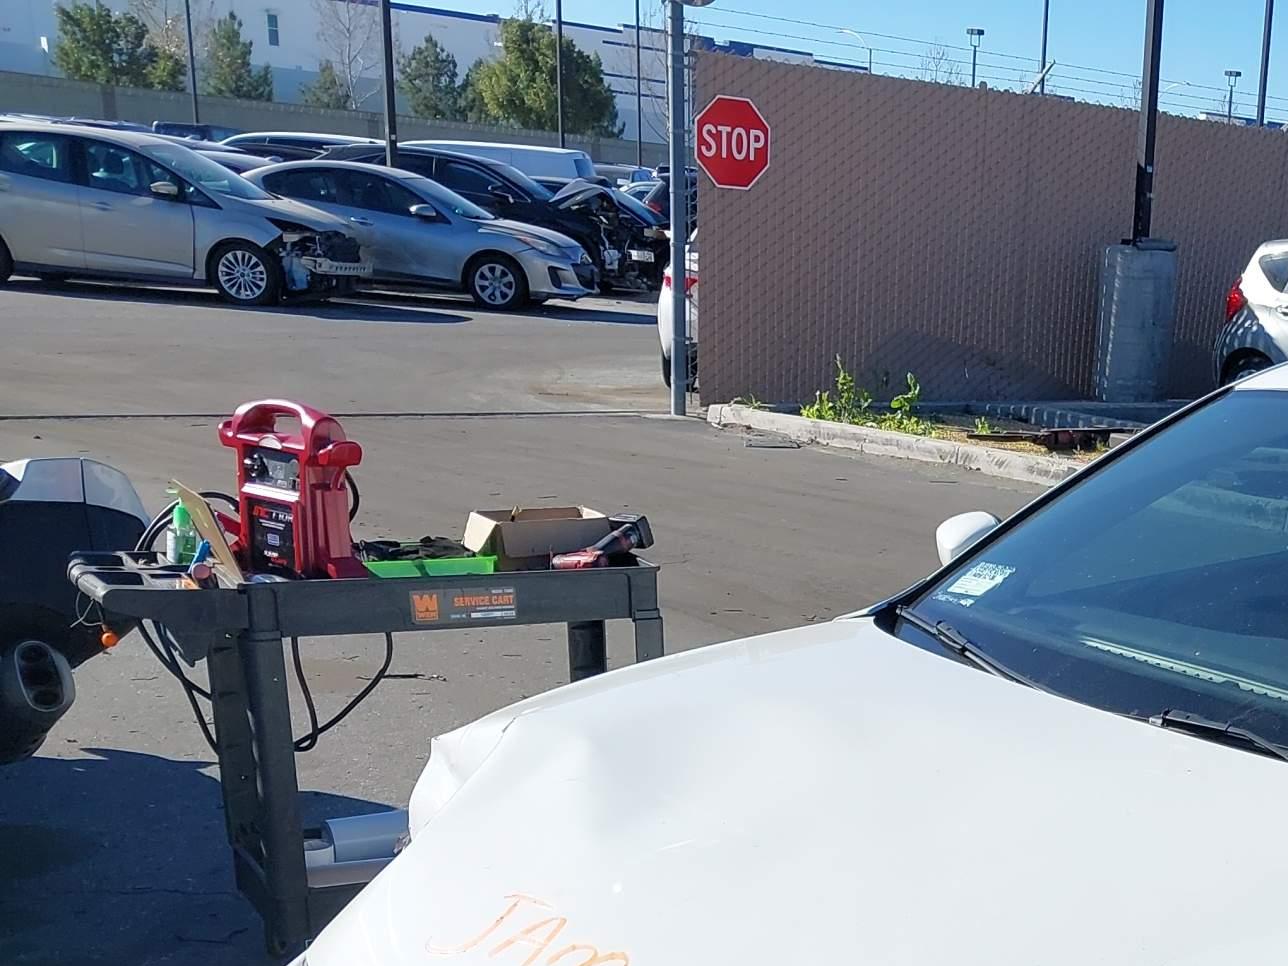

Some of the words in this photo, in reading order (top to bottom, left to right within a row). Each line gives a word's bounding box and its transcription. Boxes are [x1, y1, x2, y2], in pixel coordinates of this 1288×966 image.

[701, 123, 765, 161] STOP
[453, 595, 491, 607] SERVICE
[492, 594, 514, 605] CART
